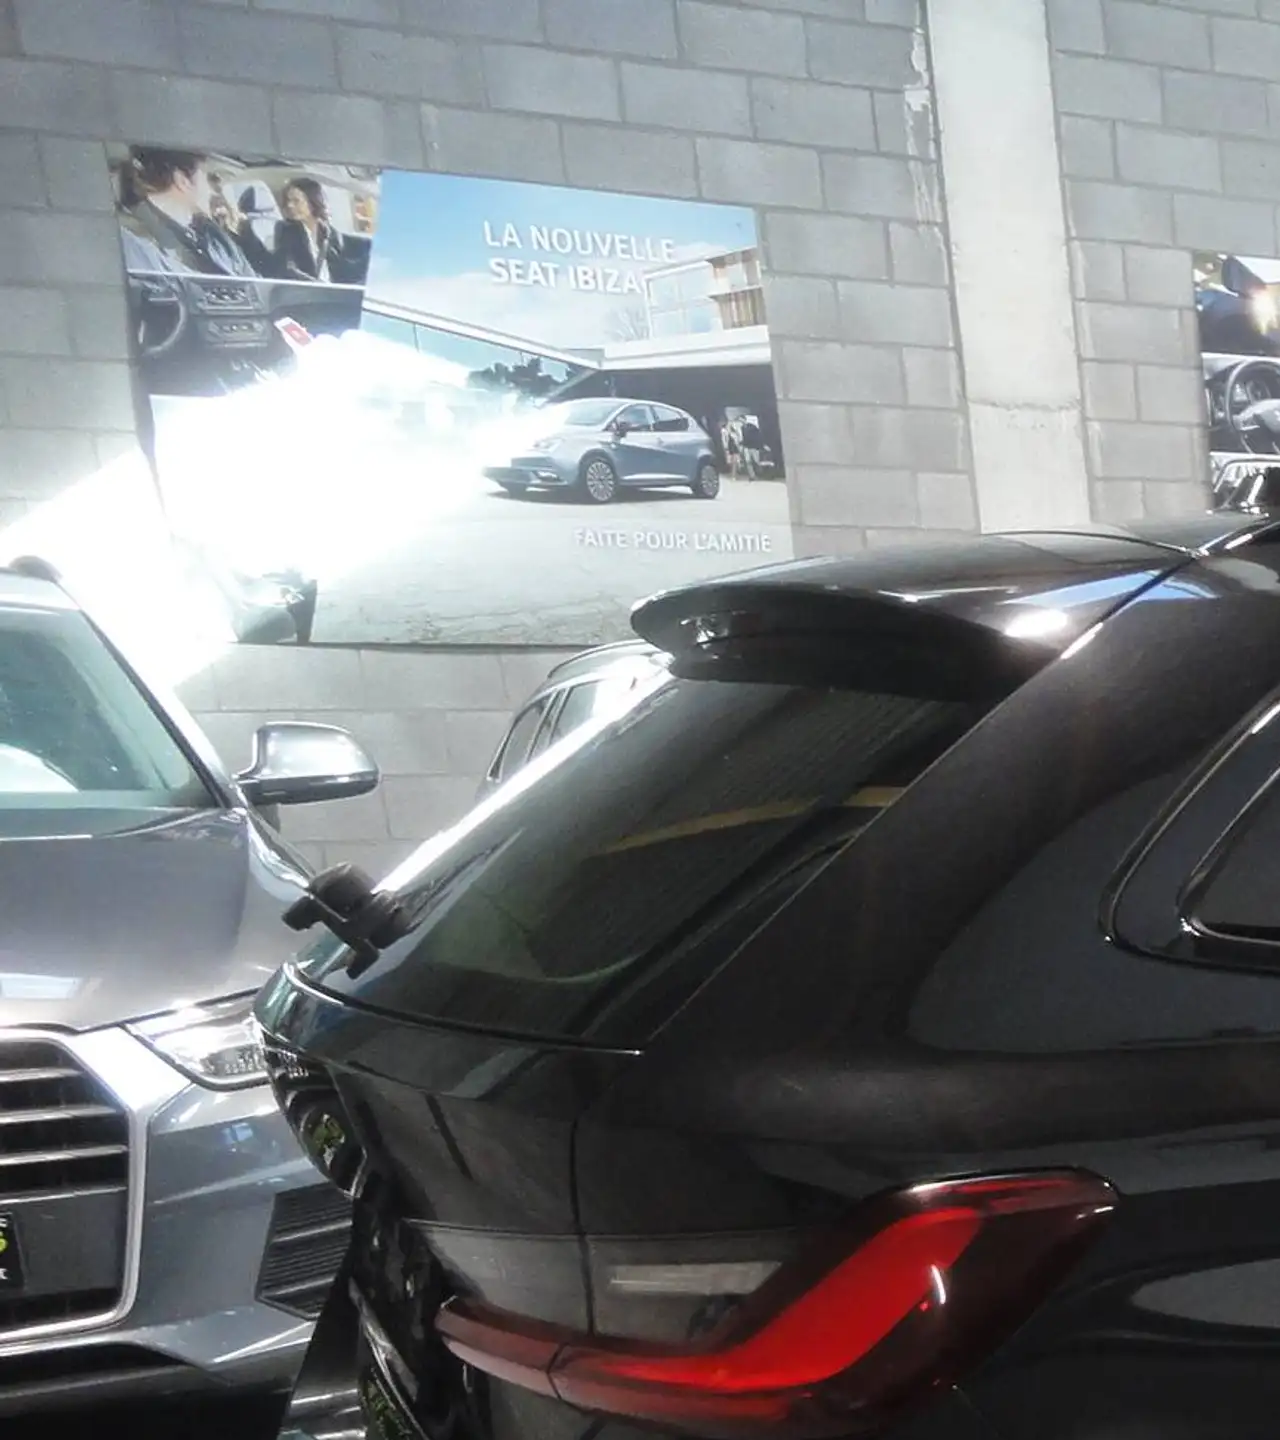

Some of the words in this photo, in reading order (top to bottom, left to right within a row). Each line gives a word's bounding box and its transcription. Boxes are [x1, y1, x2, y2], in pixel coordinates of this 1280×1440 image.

[484, 220, 522, 249] LA
[530, 225, 675, 263] NOUVELLE
[488, 257, 560, 288] SEAT
[568, 265, 642, 294] IBIZA
[574, 527, 628, 548] FAITE
[634, 531, 688, 550] POUR
